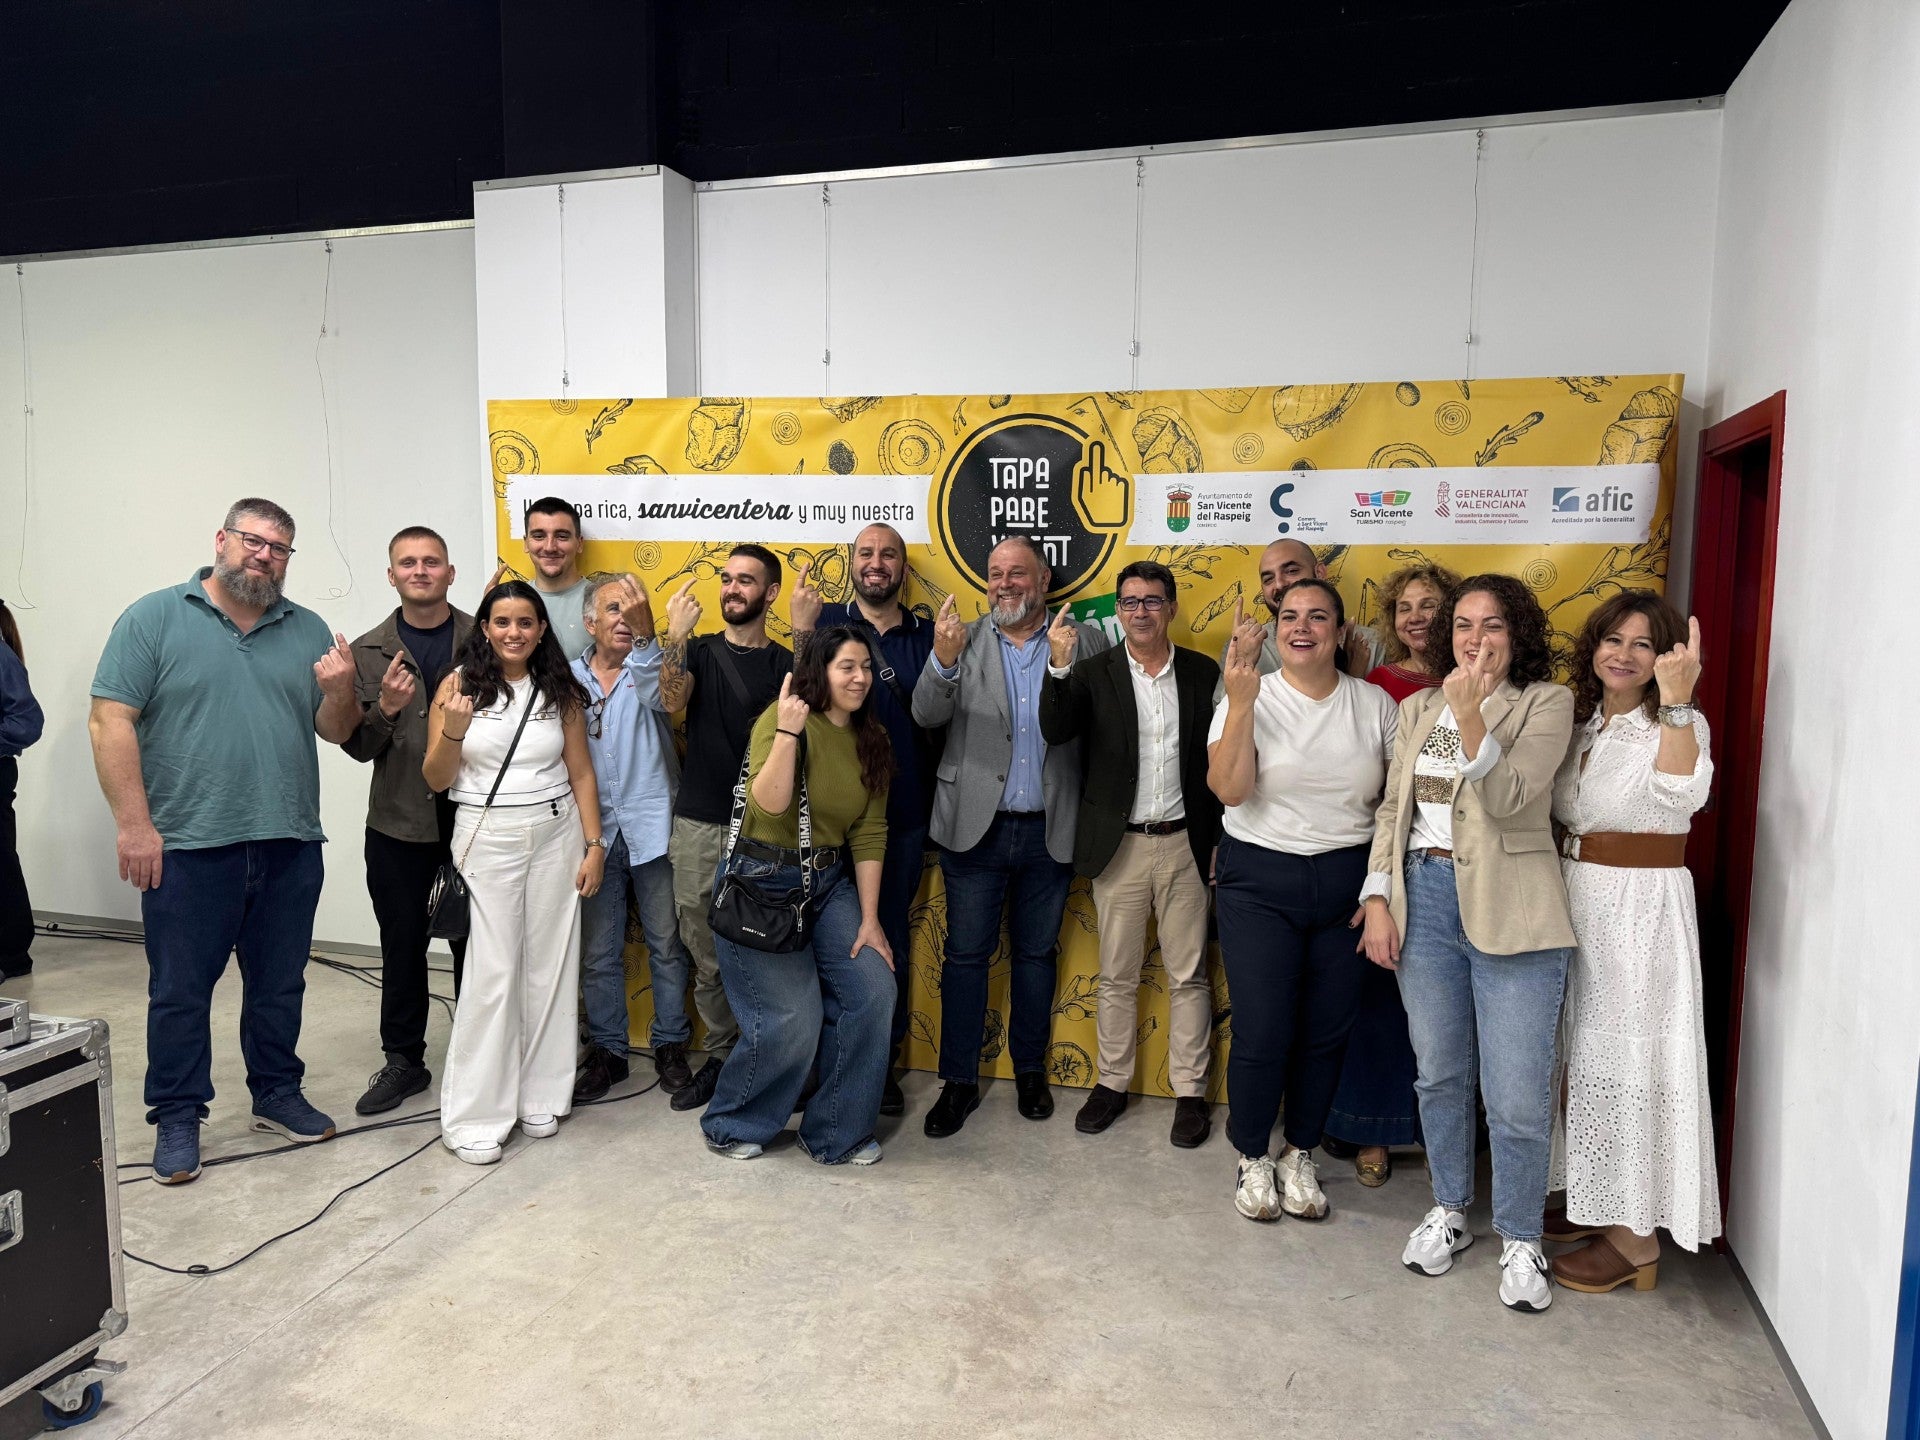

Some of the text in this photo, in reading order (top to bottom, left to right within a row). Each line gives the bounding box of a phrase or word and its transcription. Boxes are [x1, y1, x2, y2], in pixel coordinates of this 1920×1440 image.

[989, 457, 1050, 489] TAPA
[1198, 492, 1242, 500] Ayuntamiento
[1455, 489, 1529, 498] GENERALITAT
[1585, 486, 1634, 511] afic
[1197, 501, 1252, 510] San Vicente
[1456, 500, 1526, 509] VALENCIANA
[598, 500, 632, 521] rica,
[637, 498, 793, 520] sanvicentera
[798, 505, 807, 523] y
[813, 505, 846, 523] muy
[852, 503, 914, 520] nuestra
[991, 497, 1049, 527] PARE
[1350, 508, 1413, 518] San Vicente
[1197, 511, 1251, 522] del Raspeig
